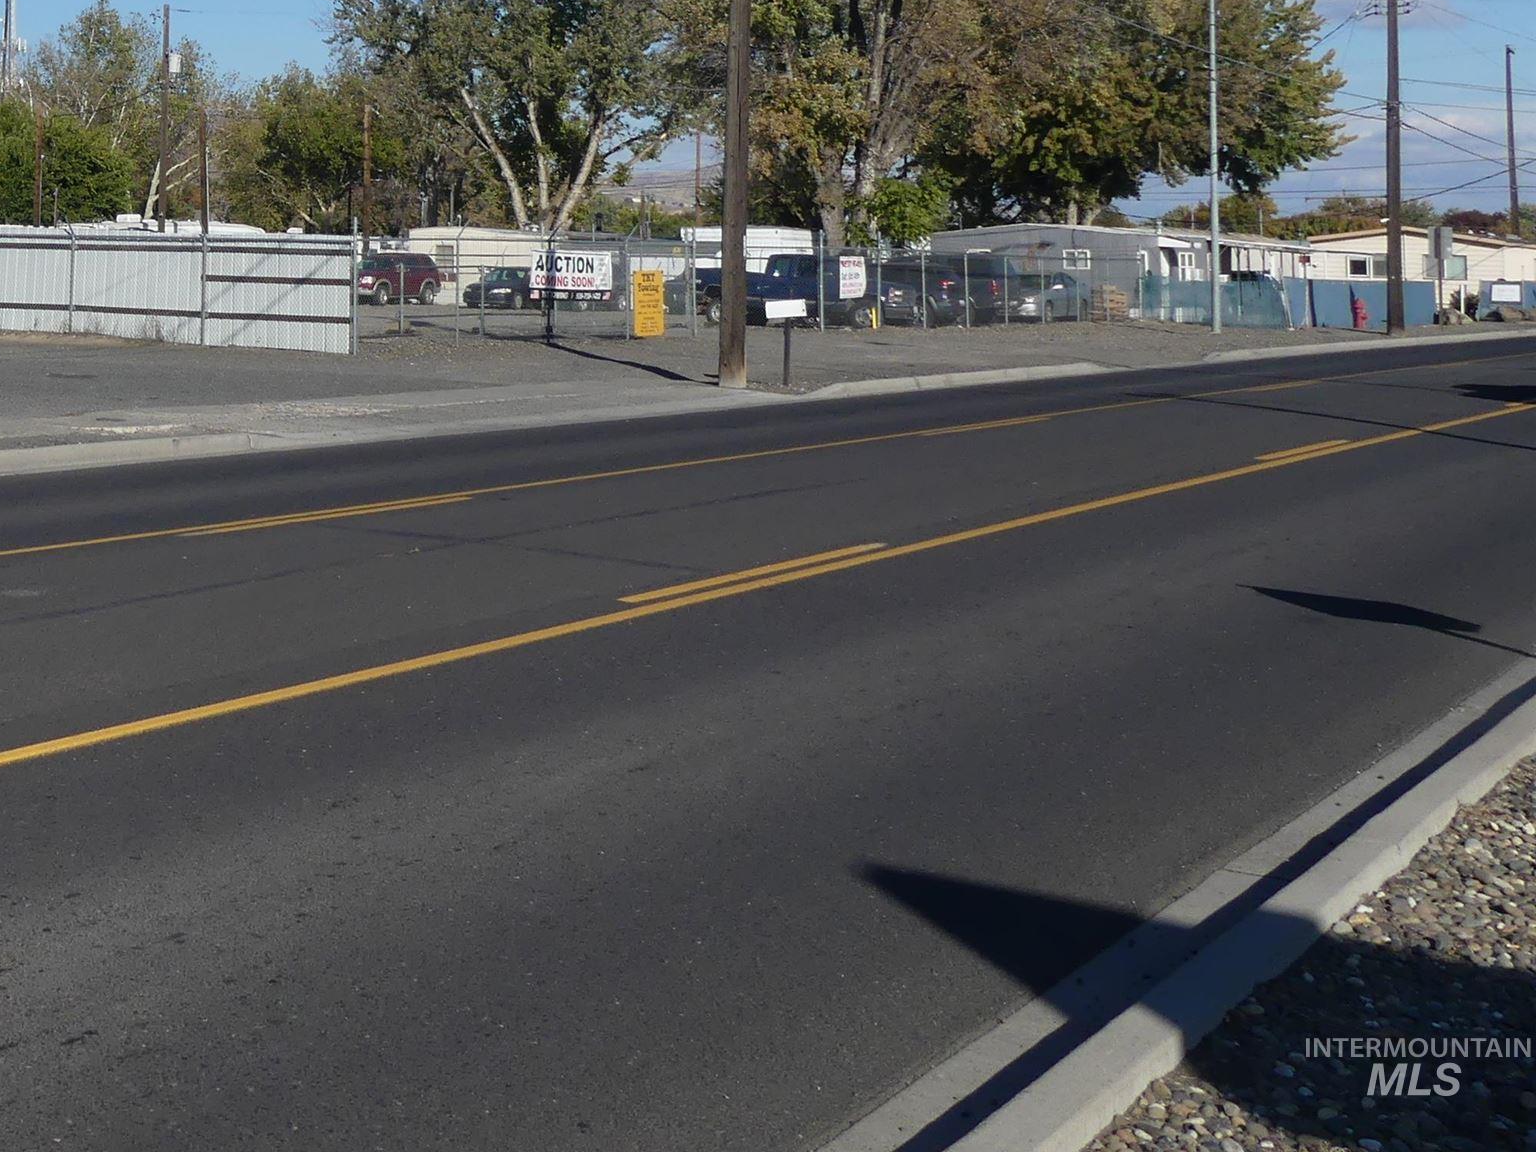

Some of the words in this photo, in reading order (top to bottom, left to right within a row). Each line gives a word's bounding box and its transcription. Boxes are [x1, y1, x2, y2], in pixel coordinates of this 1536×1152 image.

[535, 255, 594, 273] AUCTION
[535, 275, 568, 287] COMING
[571, 277, 595, 287] SOON!
